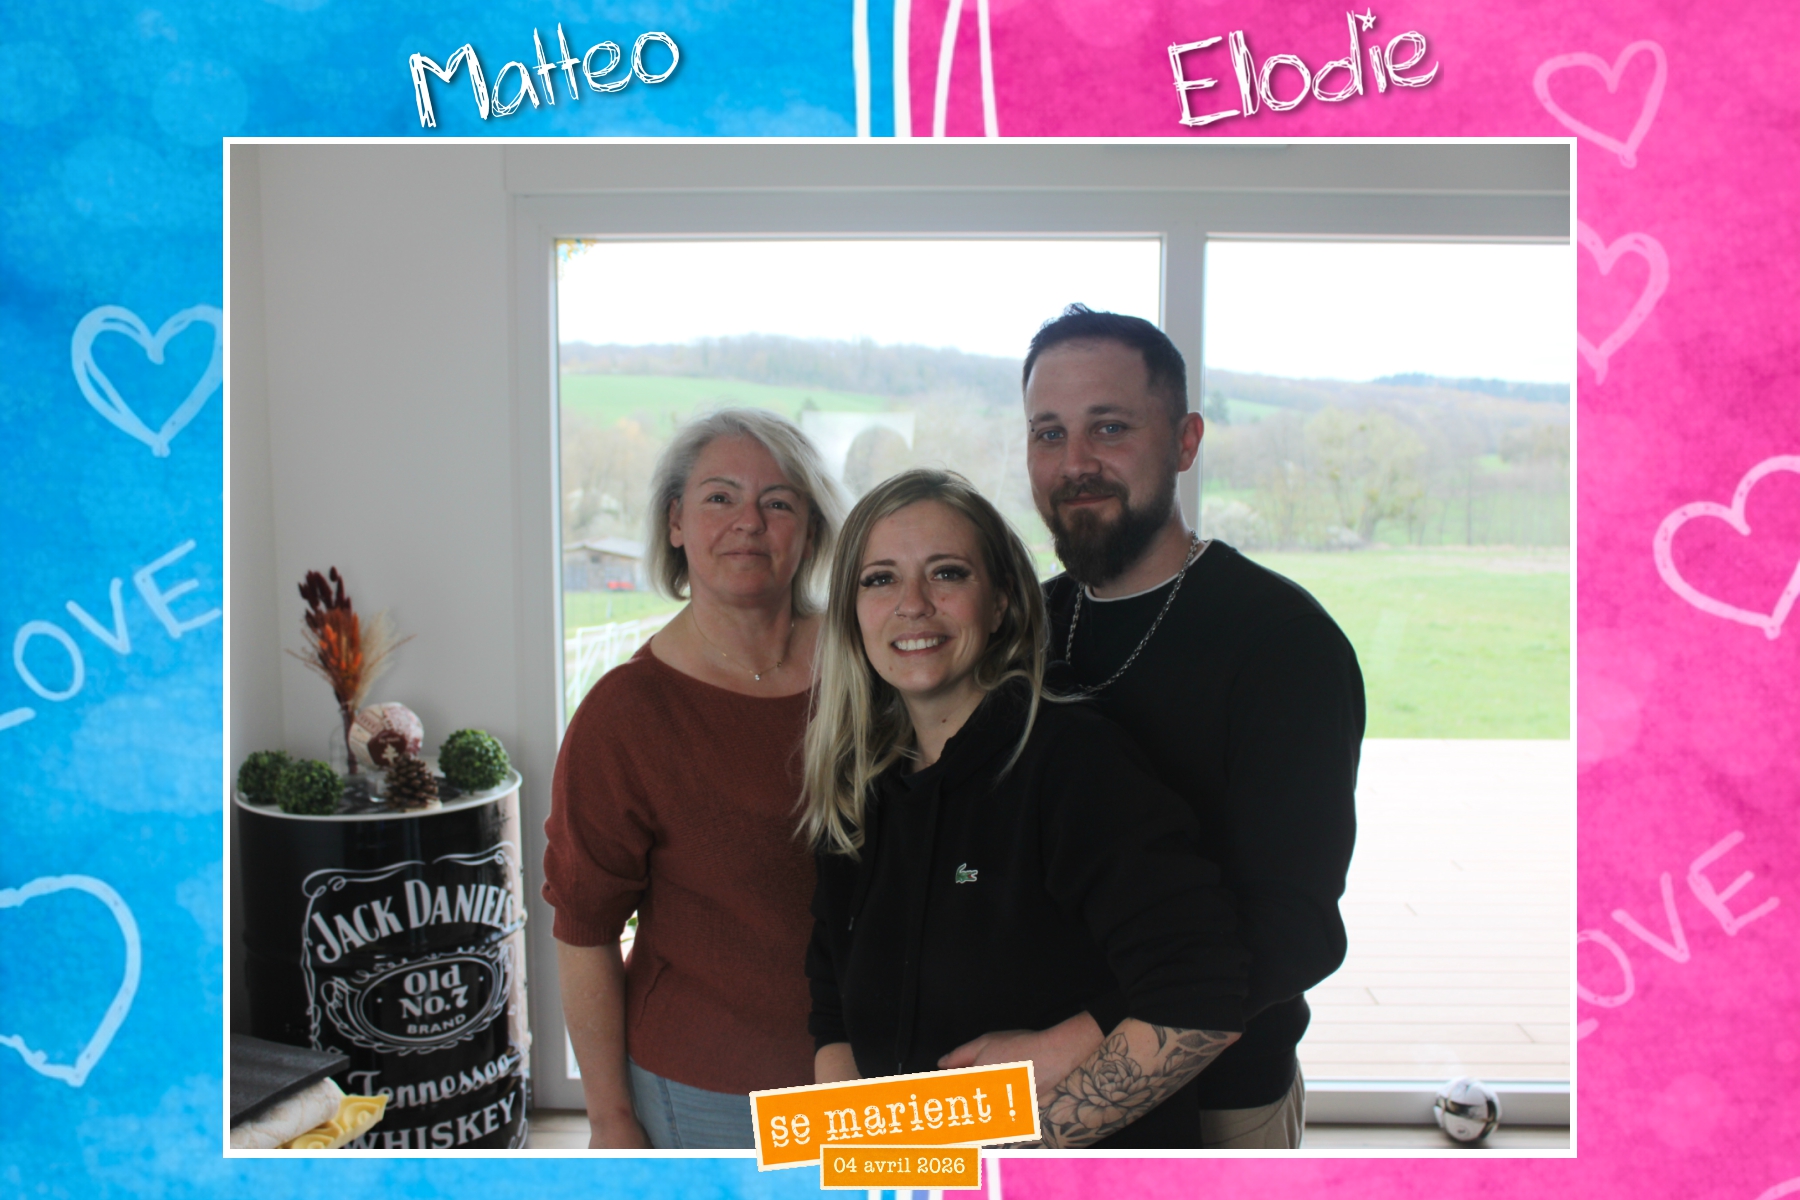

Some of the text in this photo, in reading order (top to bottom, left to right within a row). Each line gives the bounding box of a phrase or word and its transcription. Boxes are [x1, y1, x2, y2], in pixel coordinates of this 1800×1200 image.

[312, 896, 404, 964] JACK
[403, 964, 462, 996] Old
[407, 1013, 467, 1035] BRAND
[347, 1053, 521, 1111] Tennessee
